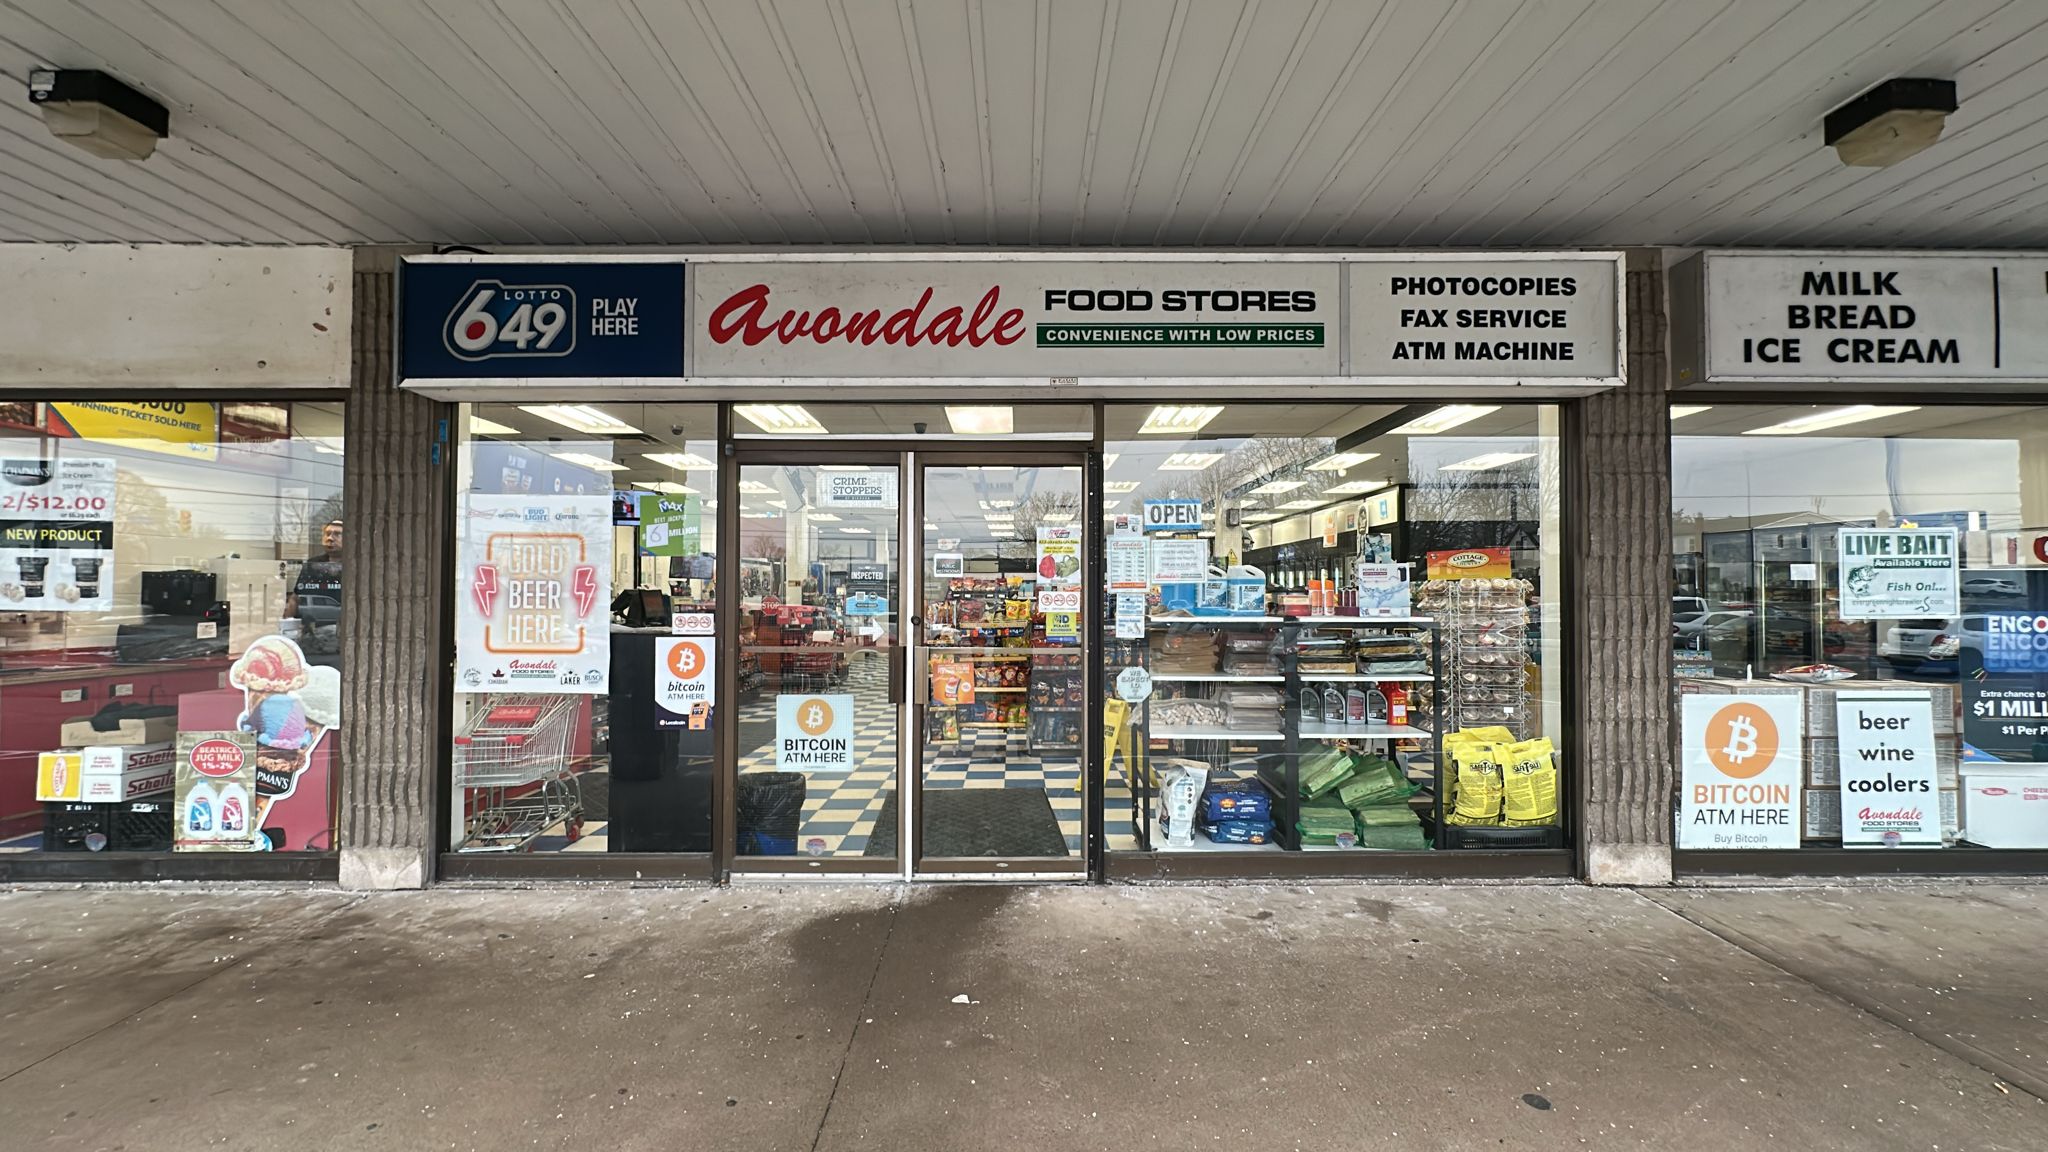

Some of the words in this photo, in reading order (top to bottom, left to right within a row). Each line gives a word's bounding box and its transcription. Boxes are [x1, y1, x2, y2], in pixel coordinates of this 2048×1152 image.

[1391, 277, 1577, 296] PHOTOCOPIES
[1801, 271, 1902, 296] MILK
[504, 290, 561, 300] LOTTO
[1045, 290, 1153, 311] FOOD
[1162, 290, 1316, 312] STORES
[592, 299, 638, 316] PLAY
[708, 284, 1026, 348] Avondale
[1401, 309, 1448, 328] FAX
[1456, 309, 1567, 328] SERVICE
[1788, 305, 1916, 330] BREAD
[591, 317, 639, 336] HERE
[1046, 329, 1164, 342] CONVENIENCE
[1169, 329, 1211, 341] WITH
[1216, 329, 1251, 341] LOW
[1256, 329, 1315, 341] PRICES
[1392, 341, 1445, 360] ATM
[1455, 341, 1574, 361] MACHINE
[1743, 338, 1801, 363] ICE
[1827, 338, 1960, 363] CREAM
[71, 401, 119, 416] WINNING
[121, 408, 153, 423] TICKET
[154, 415, 179, 428] SOLD
[179, 419, 202, 432] HERE
[833, 477, 867, 485] CRIME
[833, 486, 882, 494] STOPPERS
[3, 491, 106, 512] 2/$12.00
[658, 499, 683, 513] MAX
[1150, 504, 1198, 524] OPEN
[6, 528, 38, 541] NEW
[41, 528, 103, 542] PRODUCT
[668, 526, 699, 537] MILLION
[1845, 535, 1891, 555] LIVE
[1897, 535, 1952, 555] BAIT
[509, 544, 563, 574] COLD
[1874, 559, 1922, 567] Available
[1923, 559, 1950, 567] Here
[850, 571, 884, 580] INSPECTED
[508, 579, 560, 610] BEER
[1886, 582, 1912, 591] Fish
[762, 601, 780, 610] STOP
[507, 614, 561, 644] HERE
[1988, 615, 2048, 633] ENCO
[1988, 633, 2048, 650] ENCO
[509, 660, 557, 670] Avondale
[560, 676, 581, 686] LAKER
[584, 674, 603, 682] BUSCH
[668, 681, 705, 692] bitcoin
[1980, 690, 2002, 698] Extra
[2003, 690, 2035, 698] chance
[2036, 690, 2046, 698] to
[1973, 700, 1995, 716] $1
[1859, 710, 1910, 730] beer
[2001, 725, 2015, 735] $1
[2017, 725, 2039, 735] Per
[784, 738, 846, 751] BITCOIN
[1858, 742, 1915, 761] wine
[195, 753, 214, 762] JUG
[217, 753, 241, 762] MILK
[784, 752, 812, 763] ATM
[814, 752, 846, 763] HERE
[1848, 773, 1930, 792] coolers
[1694, 784, 1790, 804] BITCOIN
[1693, 809, 1735, 825] ATM
[1740, 809, 1790, 825] HERE
[1858, 807, 1923, 820] Avondale
[1714, 833, 1732, 843] Buy
[1735, 833, 1768, 843] Bitcoin
